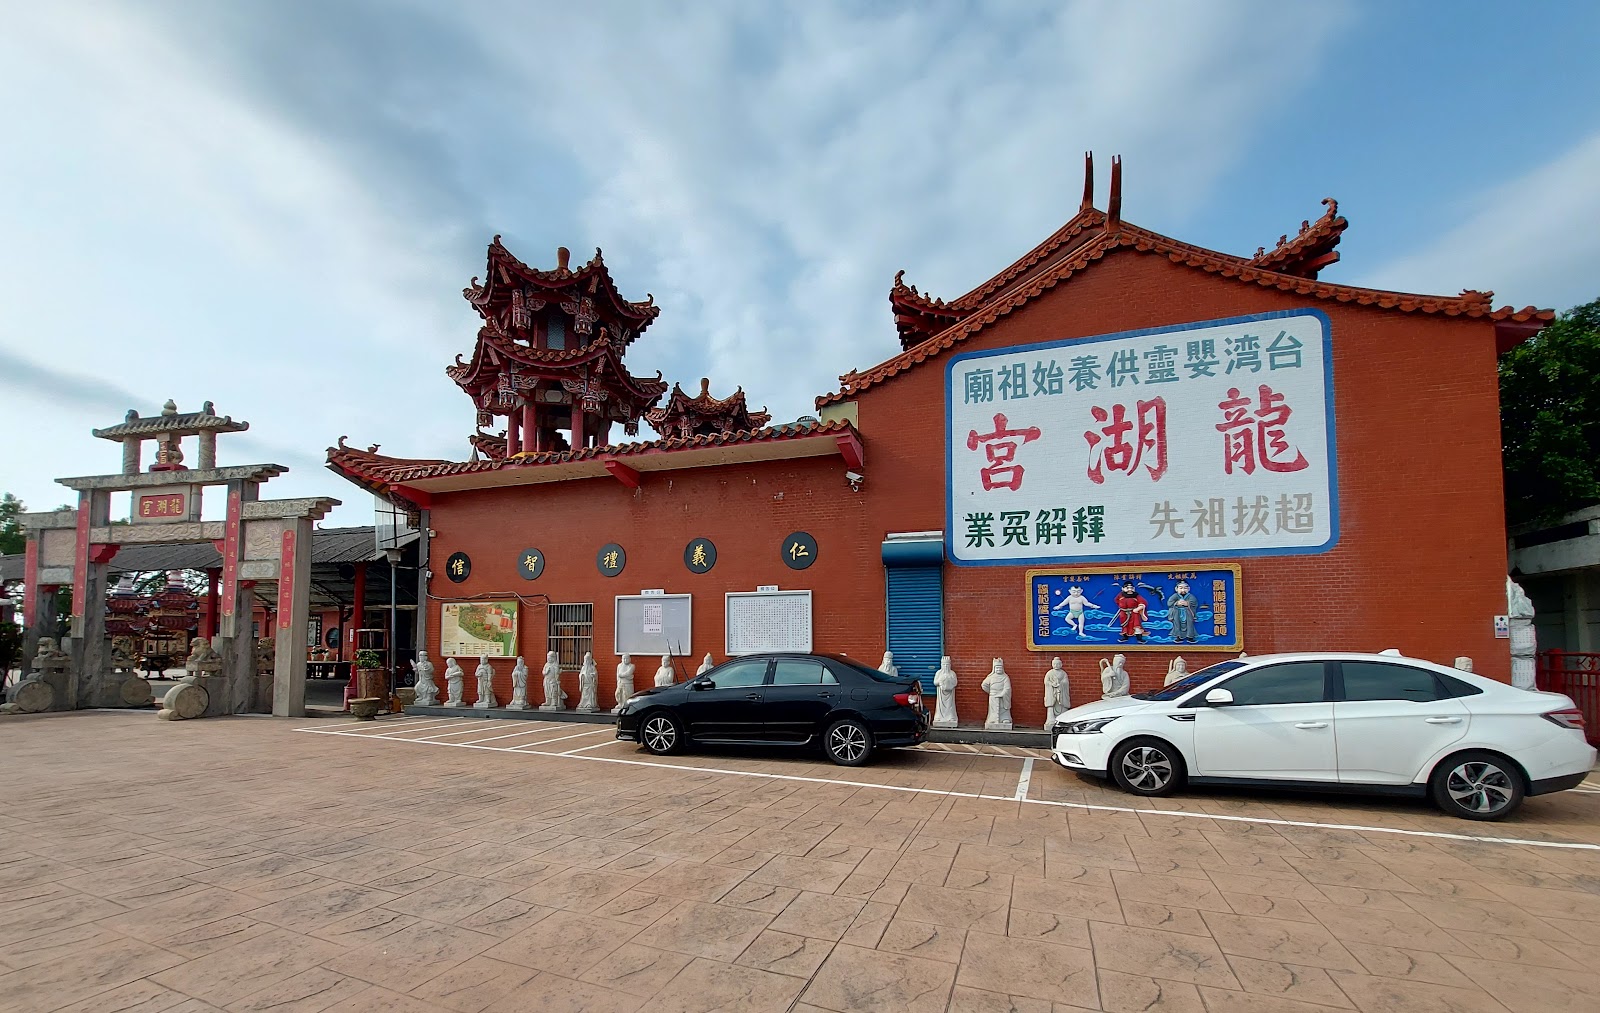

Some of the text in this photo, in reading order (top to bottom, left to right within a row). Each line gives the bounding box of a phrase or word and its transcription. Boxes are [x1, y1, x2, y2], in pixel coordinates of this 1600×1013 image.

[965, 384, 1310, 492] 龍湖宮
[603, 550, 618, 568] 禮
[692, 544, 707, 567] 義
[789, 542, 809, 560] 仁
[452, 559, 465, 575] 信
[524, 555, 538, 572] 智
